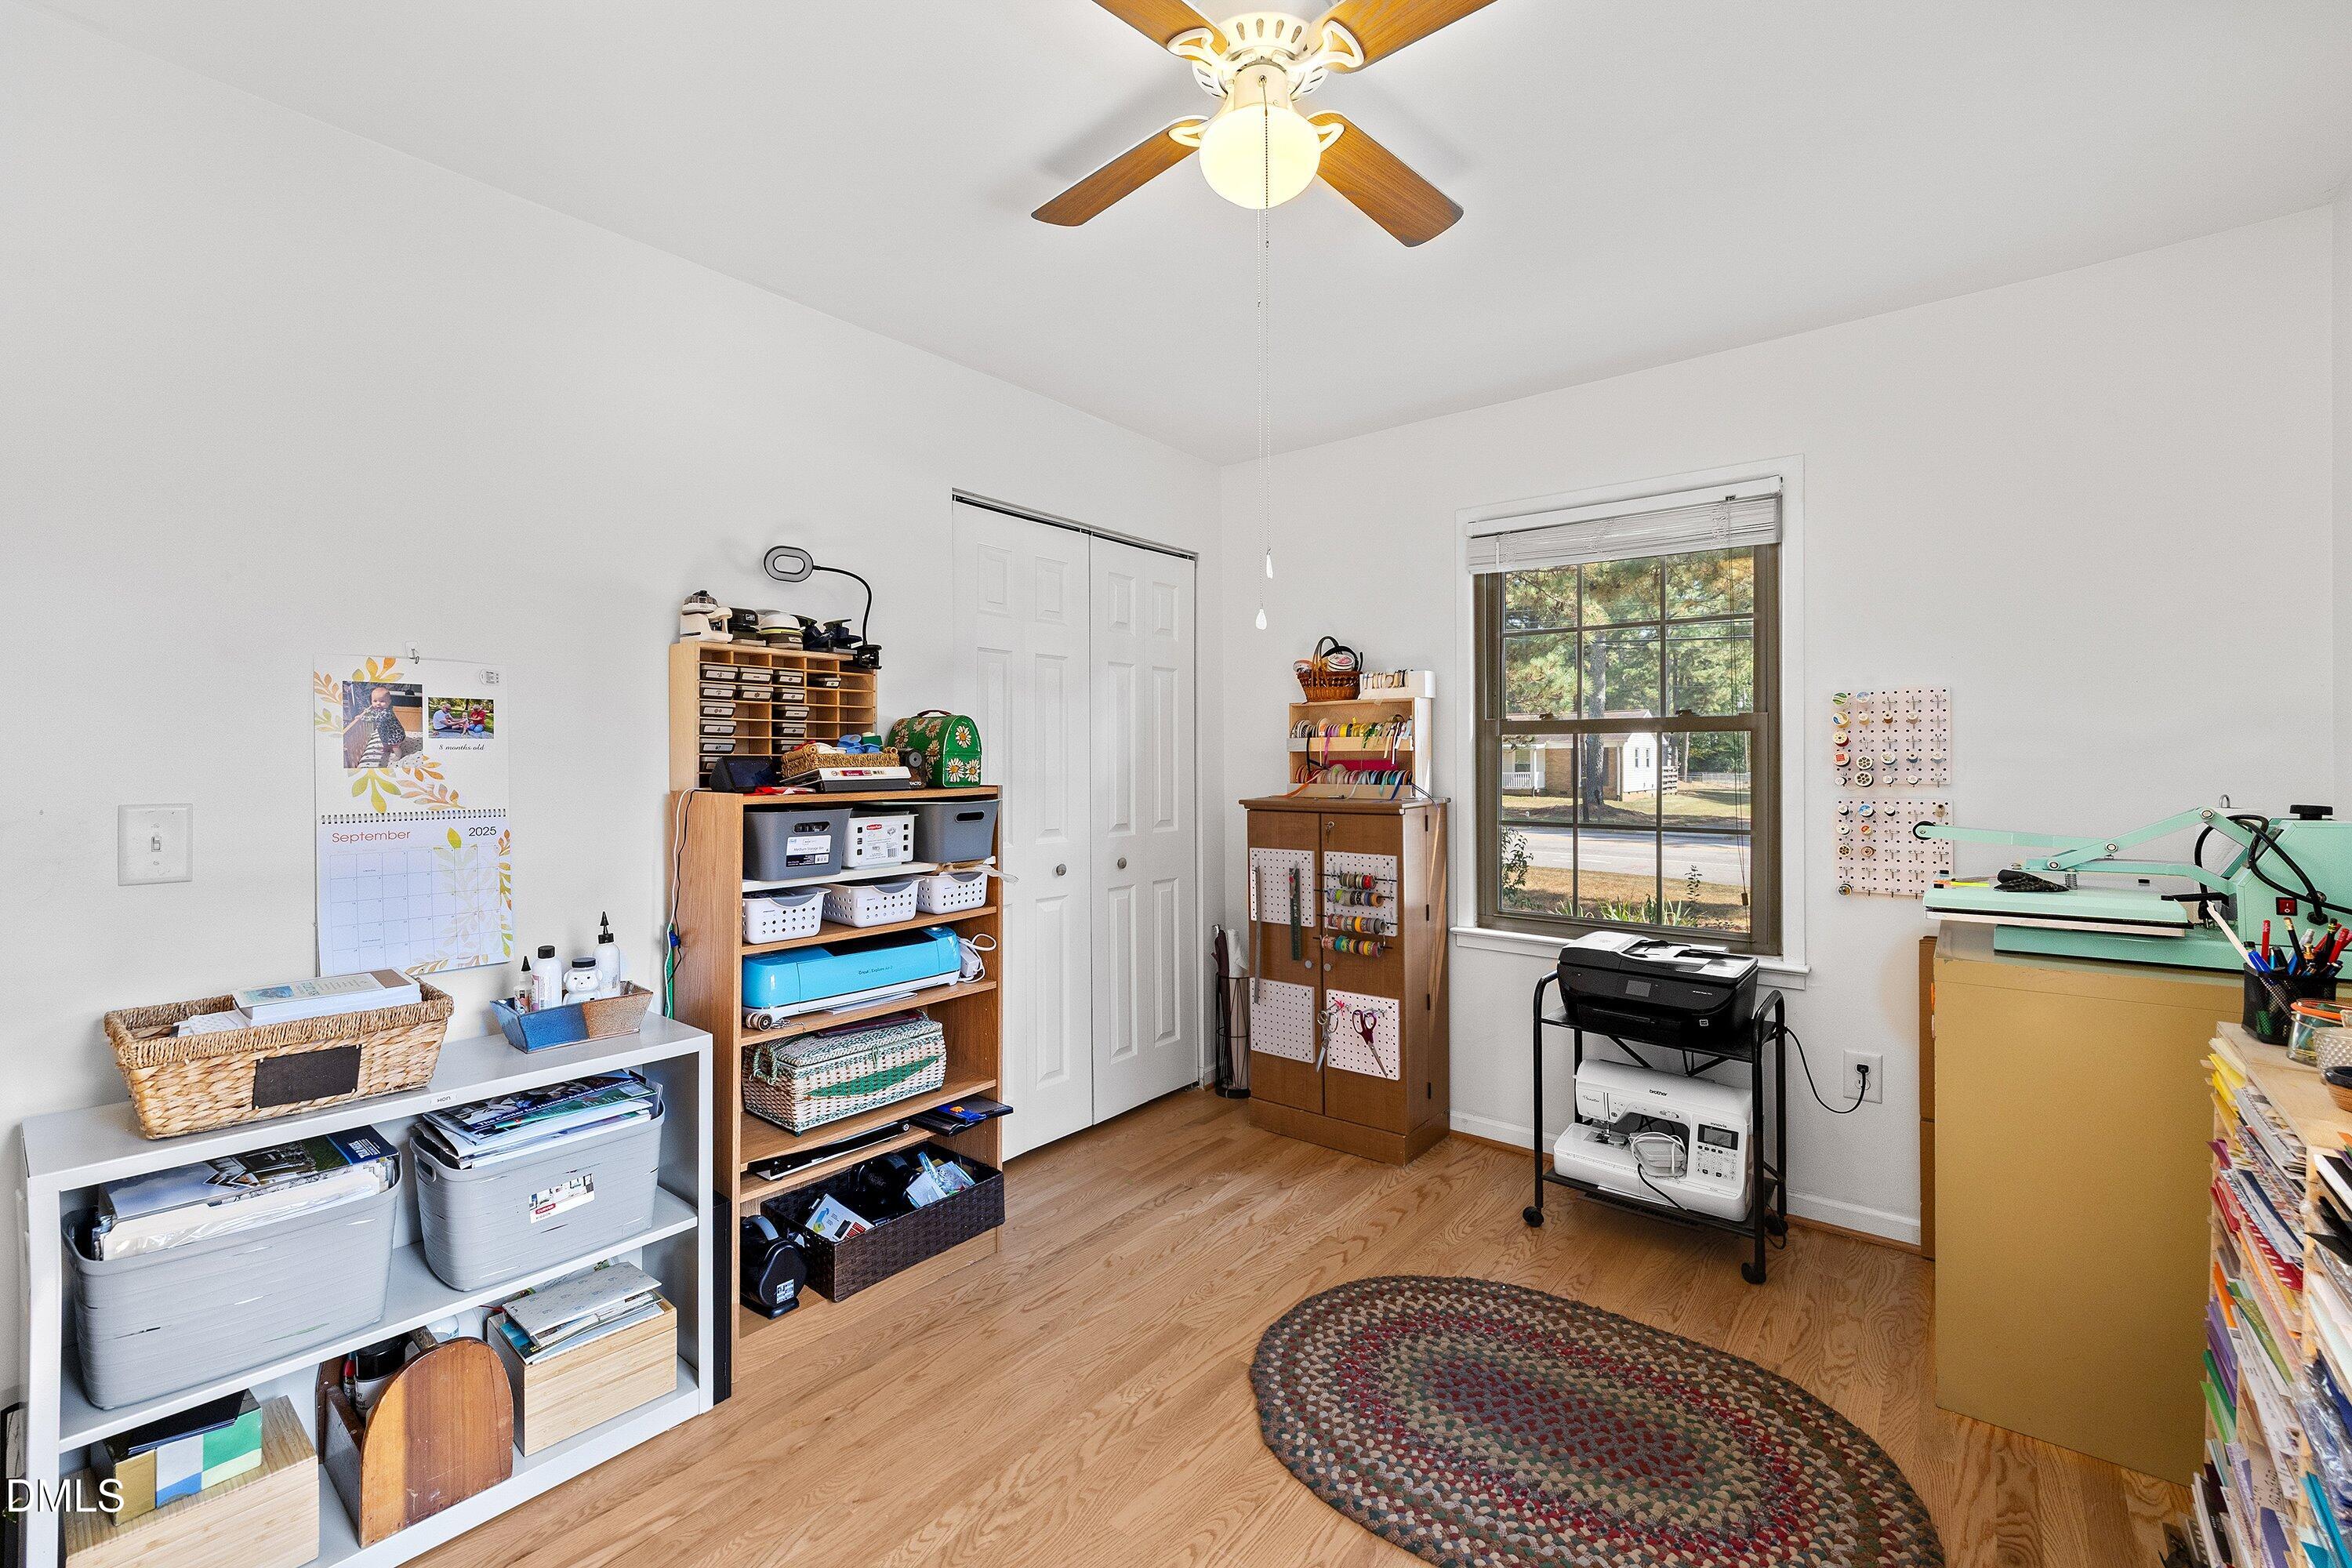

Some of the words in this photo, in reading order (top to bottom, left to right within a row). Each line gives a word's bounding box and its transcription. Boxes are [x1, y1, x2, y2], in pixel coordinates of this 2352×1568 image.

[332, 830, 412, 844] September
[468, 826, 497, 837] 2025
[495, 1110, 524, 1120] Center
[537, 1089, 595, 1109] Human-Animal
[594, 1079, 633, 1092] Interaction
